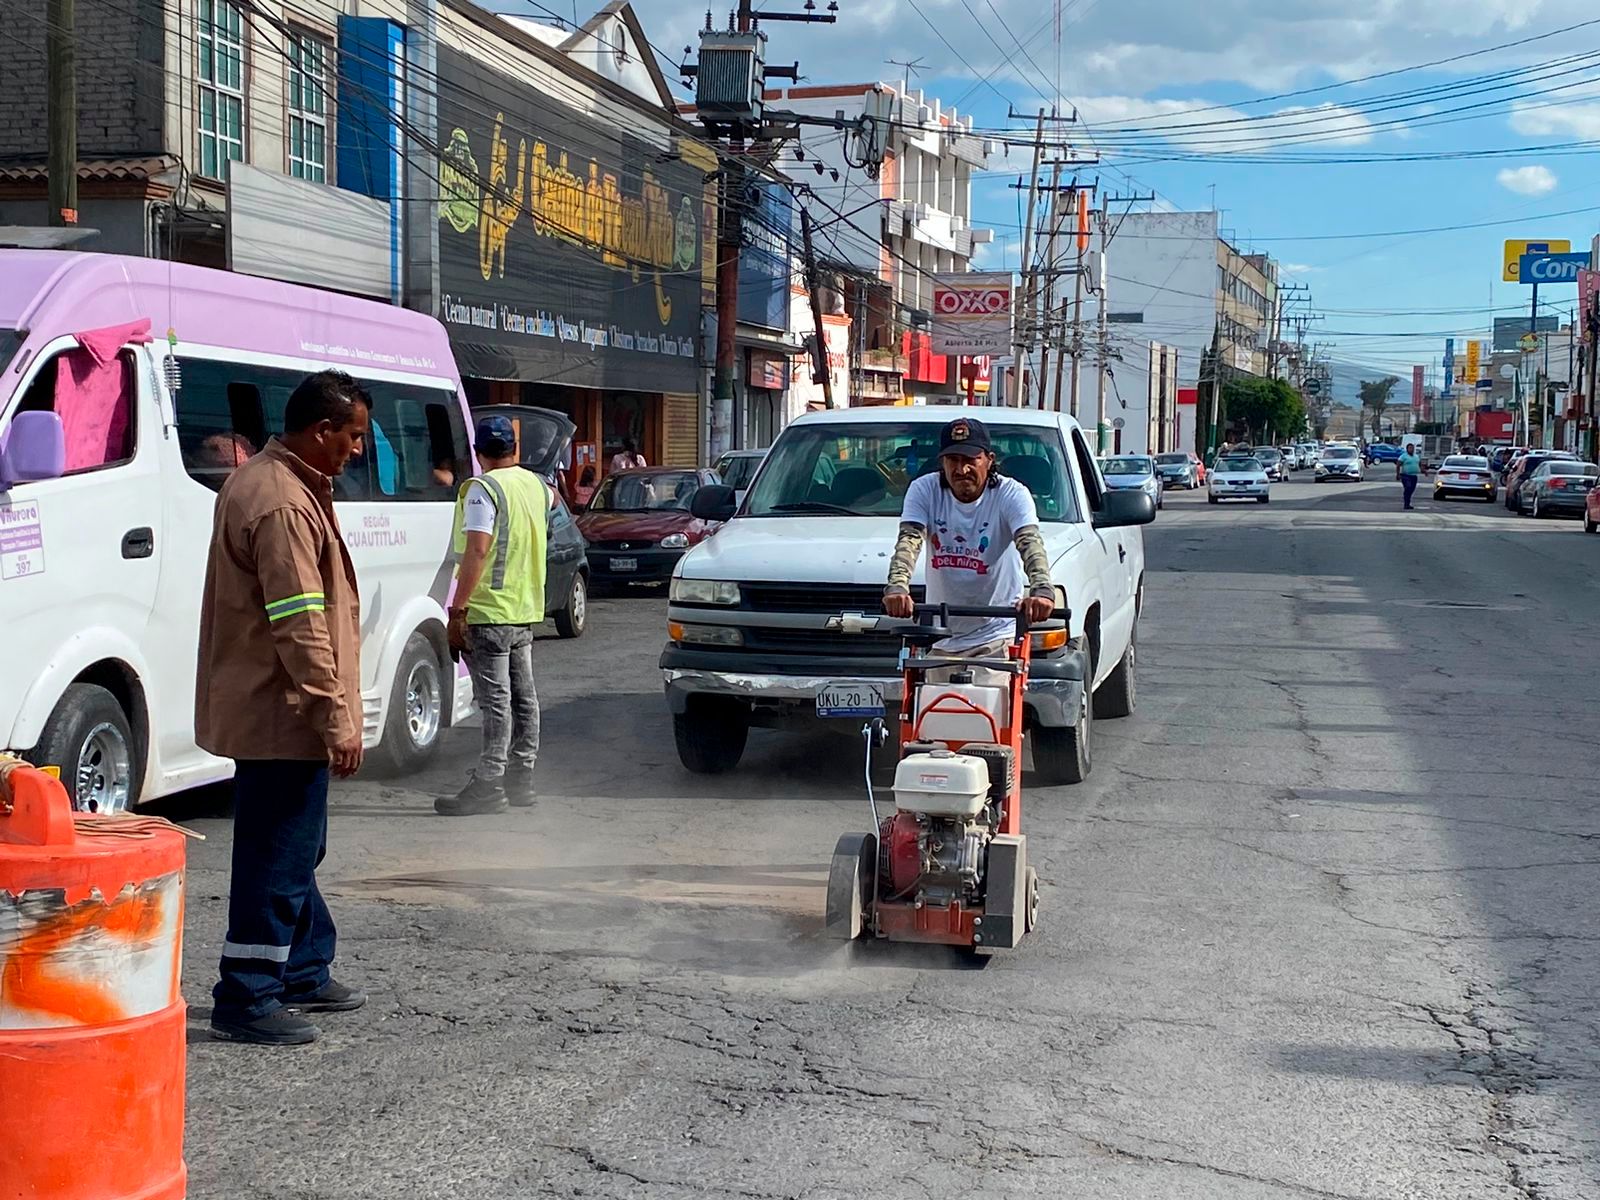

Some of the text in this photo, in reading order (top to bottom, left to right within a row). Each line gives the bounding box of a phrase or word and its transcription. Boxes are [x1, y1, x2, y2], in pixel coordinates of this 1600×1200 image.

[1530, 258, 1591, 279] Com
[940, 290, 1004, 314] OXXO
[444, 294, 471, 325] Cecina
[471, 302, 497, 330] natural
[502, 305, 526, 334] Cecina
[944, 339, 973, 347] Abierto
[974, 339, 984, 347] 24
[363, 513, 390, 528] REGIÓN
[347, 530, 407, 548] CUAUTITLAN
[16, 561, 31, 574] 397
